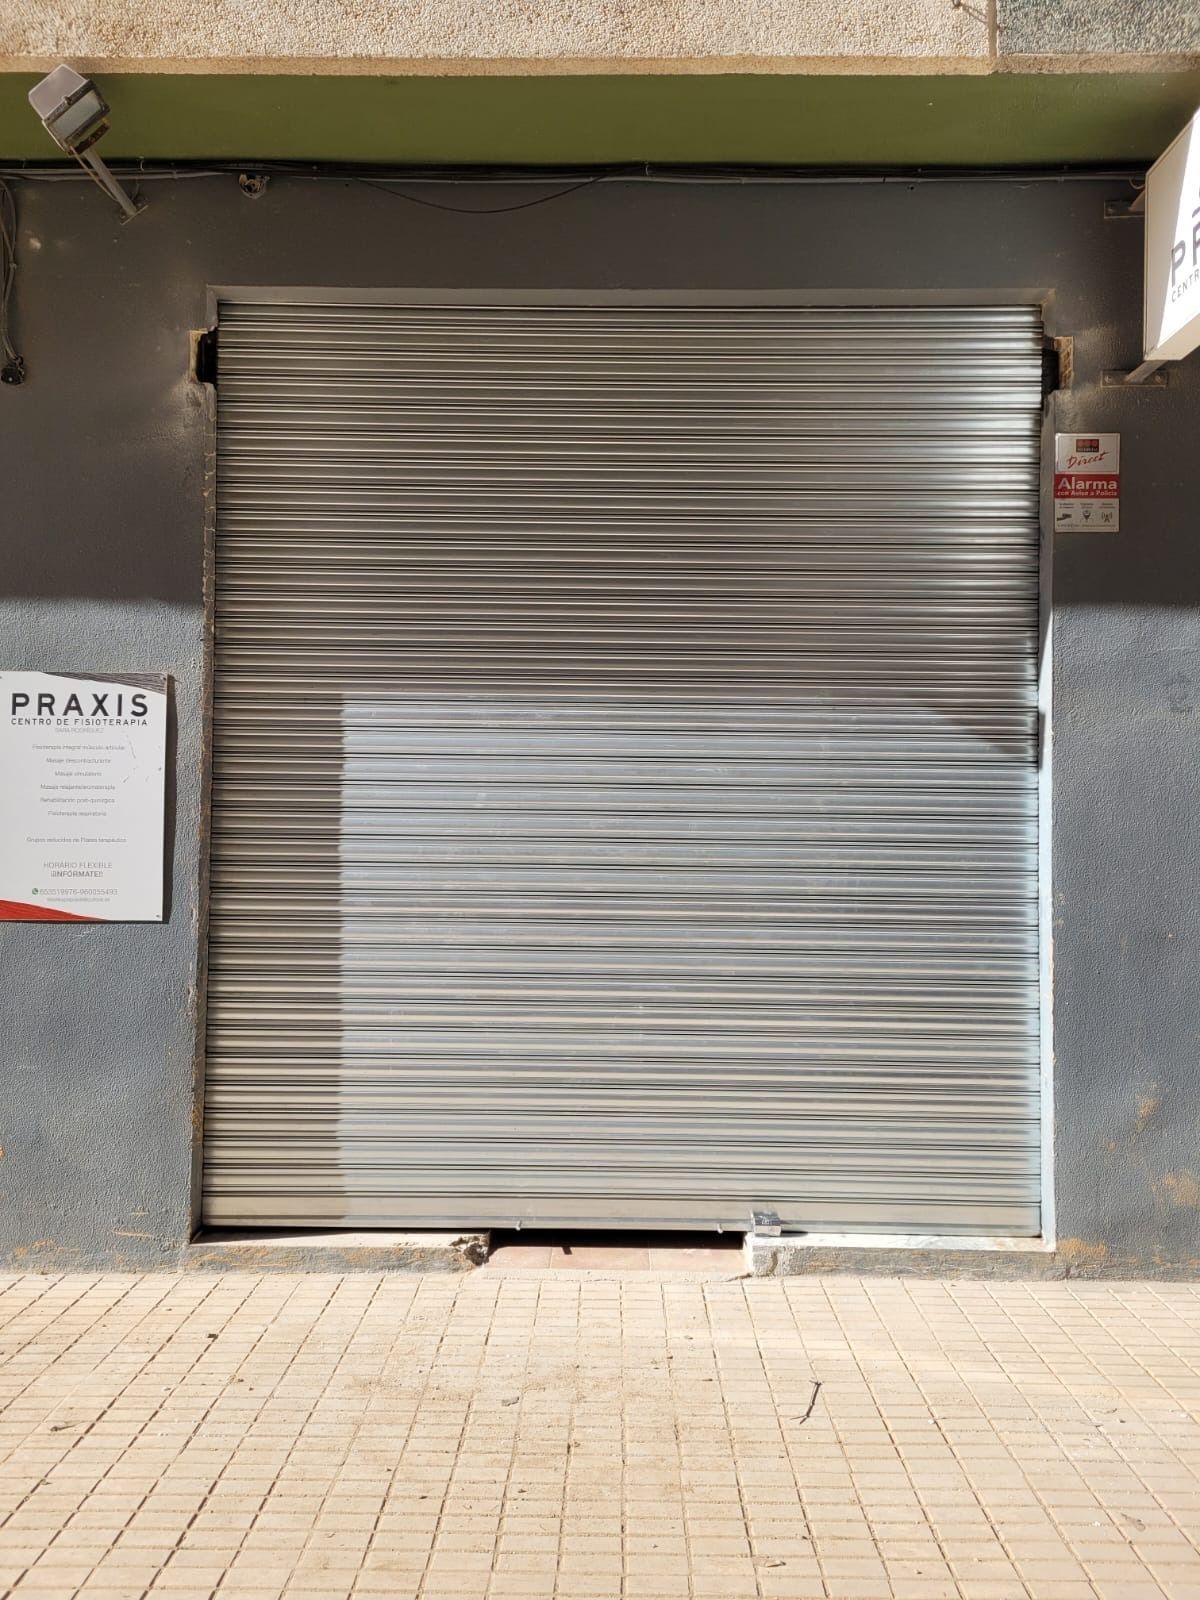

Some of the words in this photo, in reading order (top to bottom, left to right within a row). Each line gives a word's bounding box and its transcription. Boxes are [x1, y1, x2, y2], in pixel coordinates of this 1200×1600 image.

[1066, 450, 1112, 470] Direct
[1057, 476, 1118, 490] Alarma
[11, 692, 149, 717] PRAXIS
[10, 718, 52, 726] CENTRO
[56, 718, 69, 726] DE
[74, 718, 148, 727] FISIOTERAPIA
